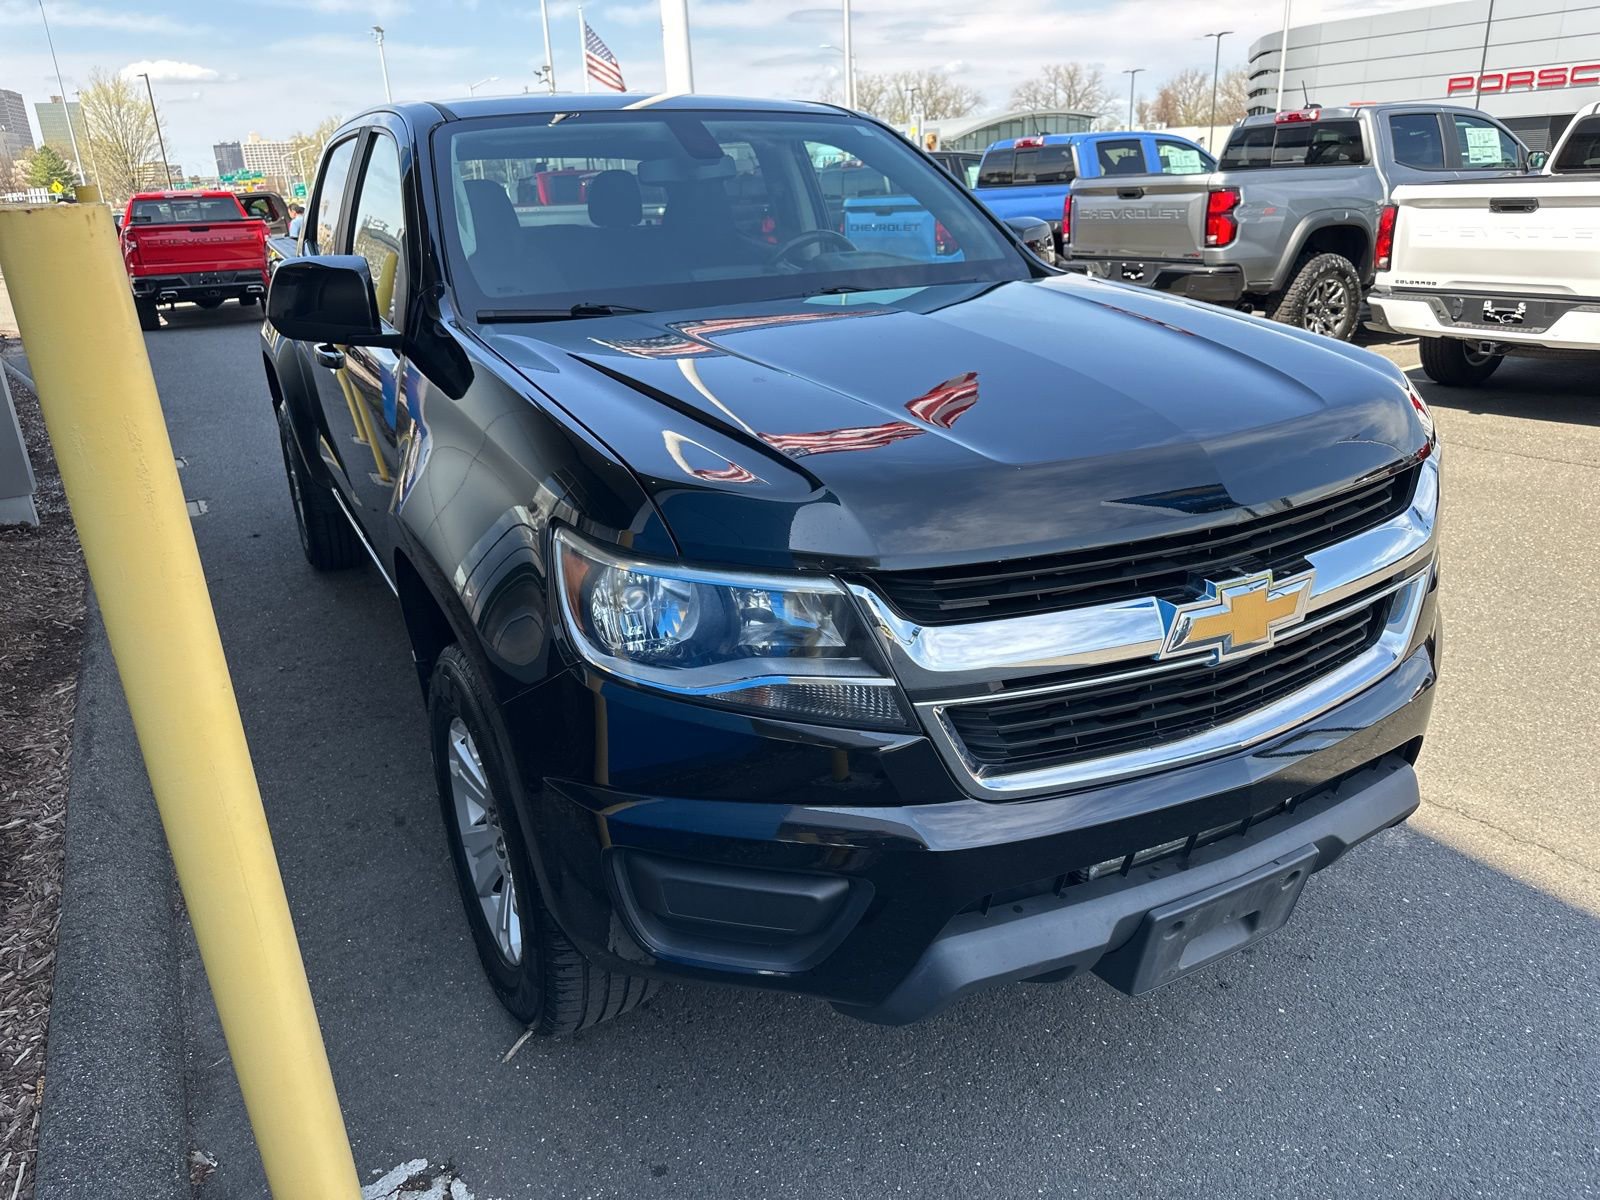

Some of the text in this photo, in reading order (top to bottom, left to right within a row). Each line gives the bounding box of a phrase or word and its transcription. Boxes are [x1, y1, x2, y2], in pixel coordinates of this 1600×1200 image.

[1447, 64, 1600, 96] PORSC
[1079, 208, 1186, 220] CHEVROLET
[849, 223, 922, 232] CHEVROLET
